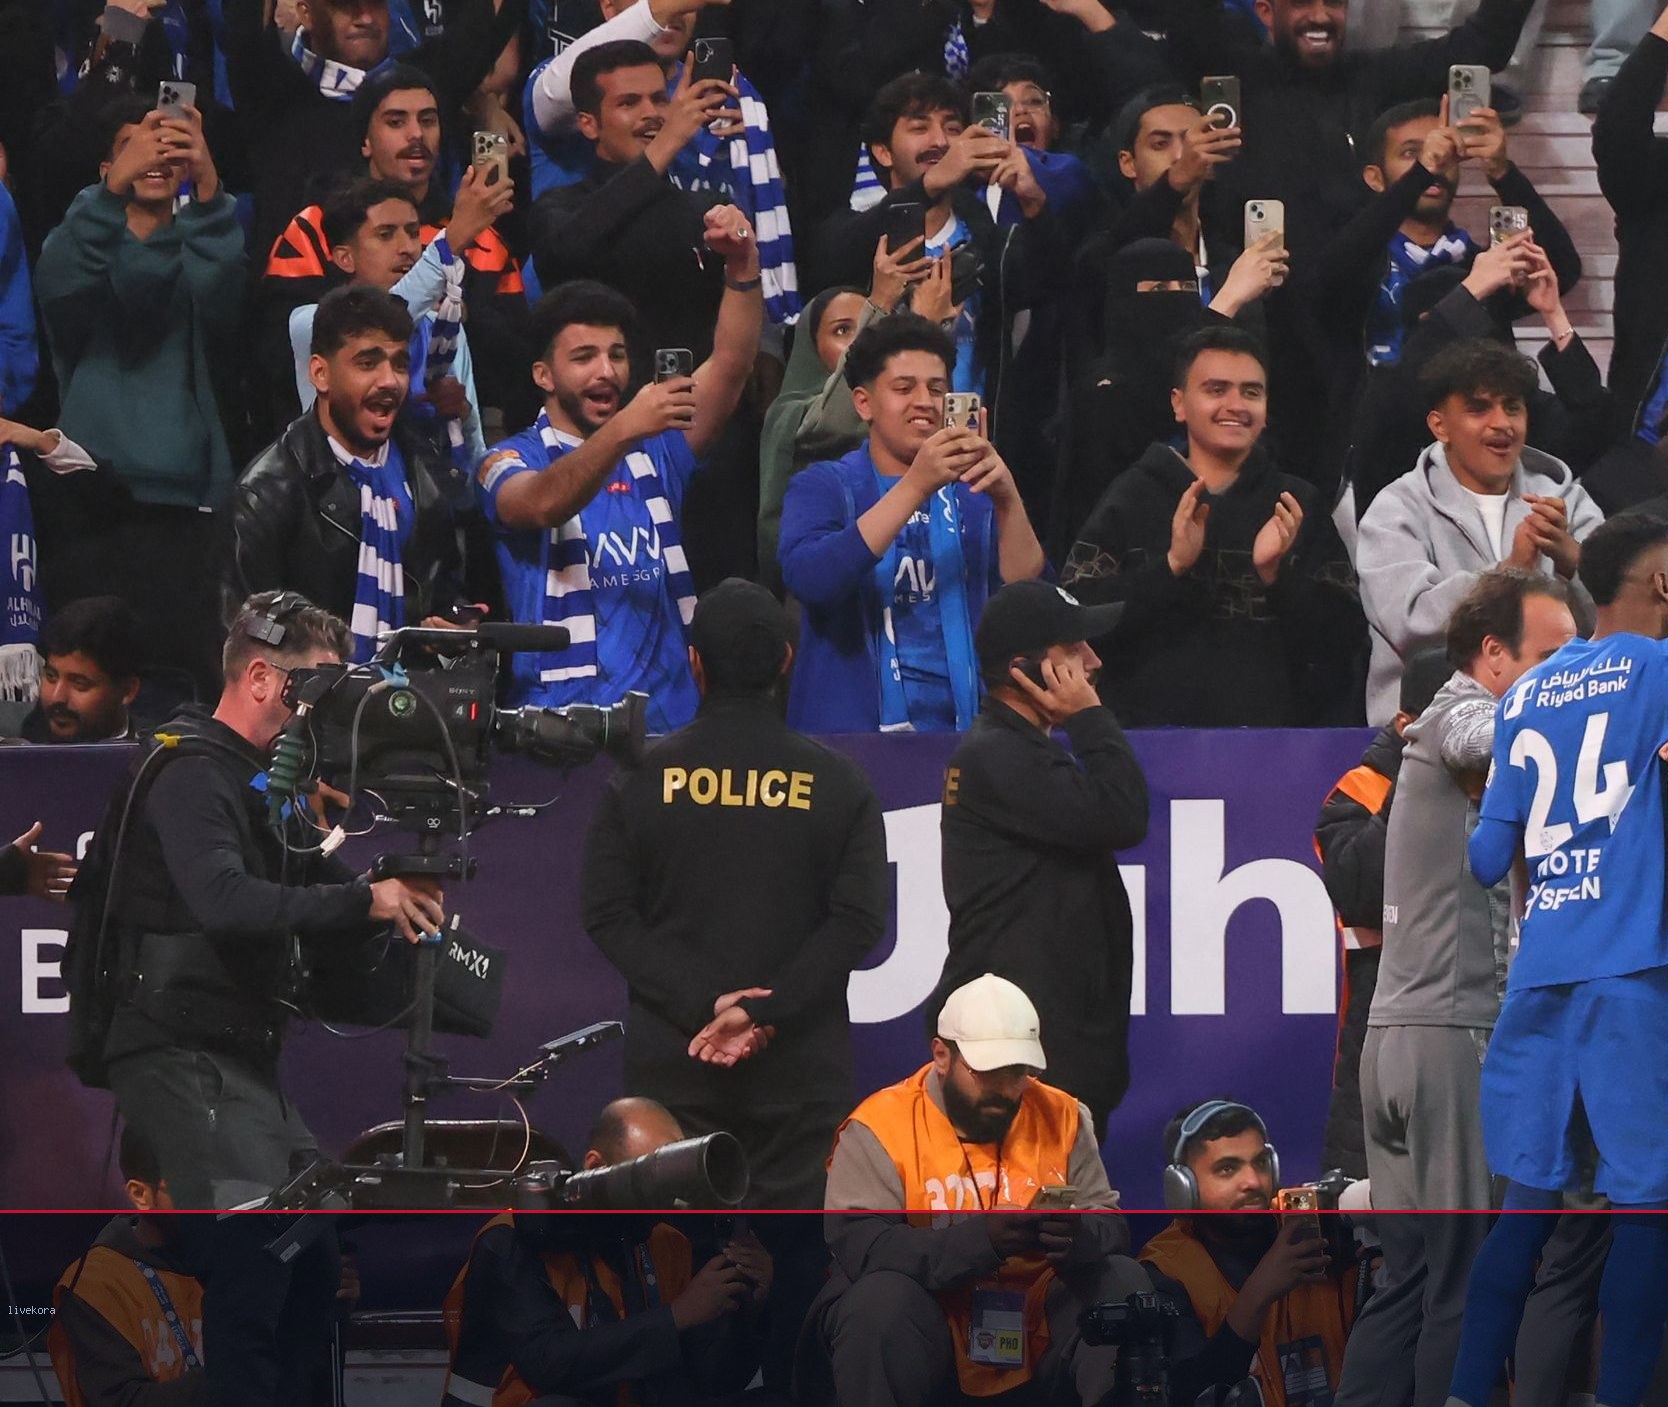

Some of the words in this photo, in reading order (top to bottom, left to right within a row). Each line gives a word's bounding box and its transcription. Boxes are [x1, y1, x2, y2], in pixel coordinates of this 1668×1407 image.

[1537, 684, 1584, 708] Riyad
[1587, 676, 1629, 698] Bank
[662, 766, 815, 811] POLICE
[1510, 712, 1636, 857] 24
